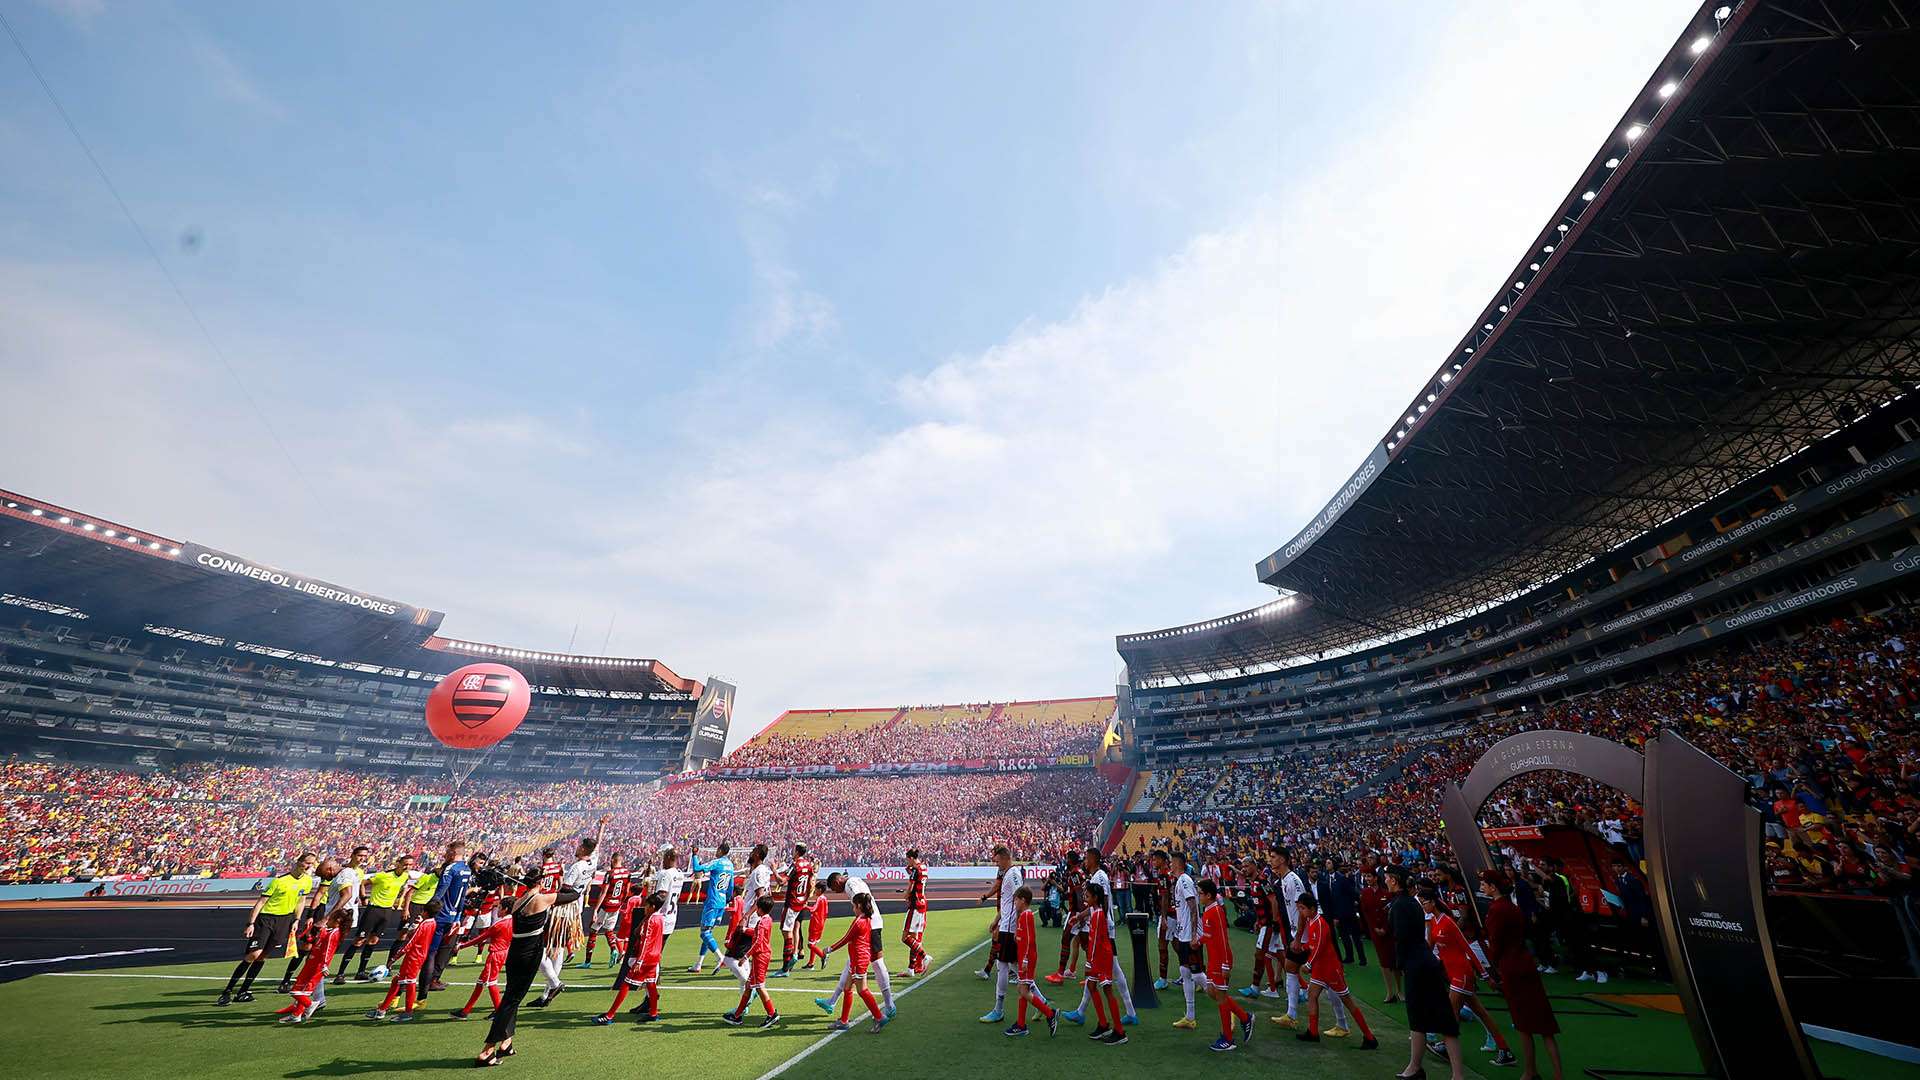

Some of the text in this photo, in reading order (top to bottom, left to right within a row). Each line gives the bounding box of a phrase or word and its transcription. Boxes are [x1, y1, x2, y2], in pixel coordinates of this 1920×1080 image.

[1826, 455, 1906, 495] GUAYAQUIL
[1285, 460, 1376, 558] CONMEBOL LIBERTADORES
[1681, 503, 1797, 562] CONMEBOL LIBERTADORES
[197, 552, 396, 616] CONMEBOL LIBERTADORES
[1725, 577, 1858, 629] CONMEBOL LIBERTADORES
[1602, 592, 1694, 633] CONMEBOL LIBERTADORES
[27, 669, 93, 684] LIBERTADORES
[1528, 673, 1569, 691] LIBERTADORES
[1510, 755, 1554, 772] GUAYAQUIL
[112, 880, 210, 897] Santander
[1689, 918, 1743, 932] LIBERTADORES
